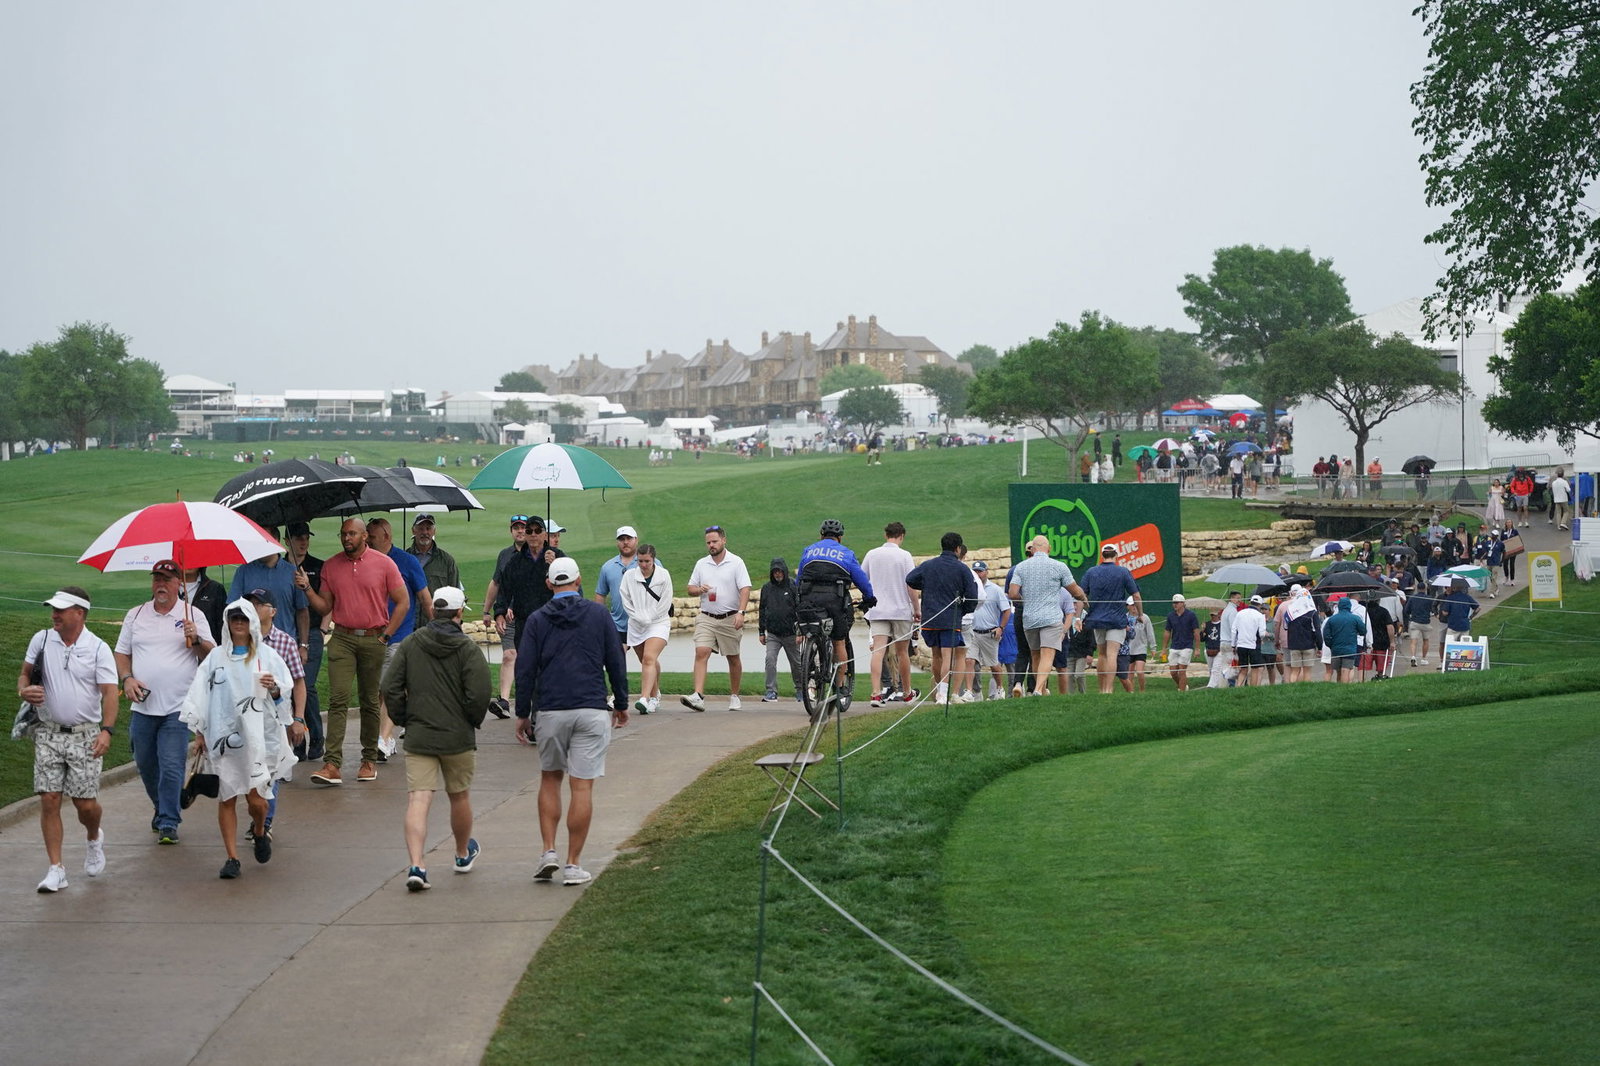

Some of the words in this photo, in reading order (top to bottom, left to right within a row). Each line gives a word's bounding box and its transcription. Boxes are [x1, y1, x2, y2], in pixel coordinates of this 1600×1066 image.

[218, 475, 305, 508] TaylorMade
[807, 547, 845, 561] POLICE
[1028, 524, 1096, 568] bigo
[1116, 540, 1139, 558] Live
